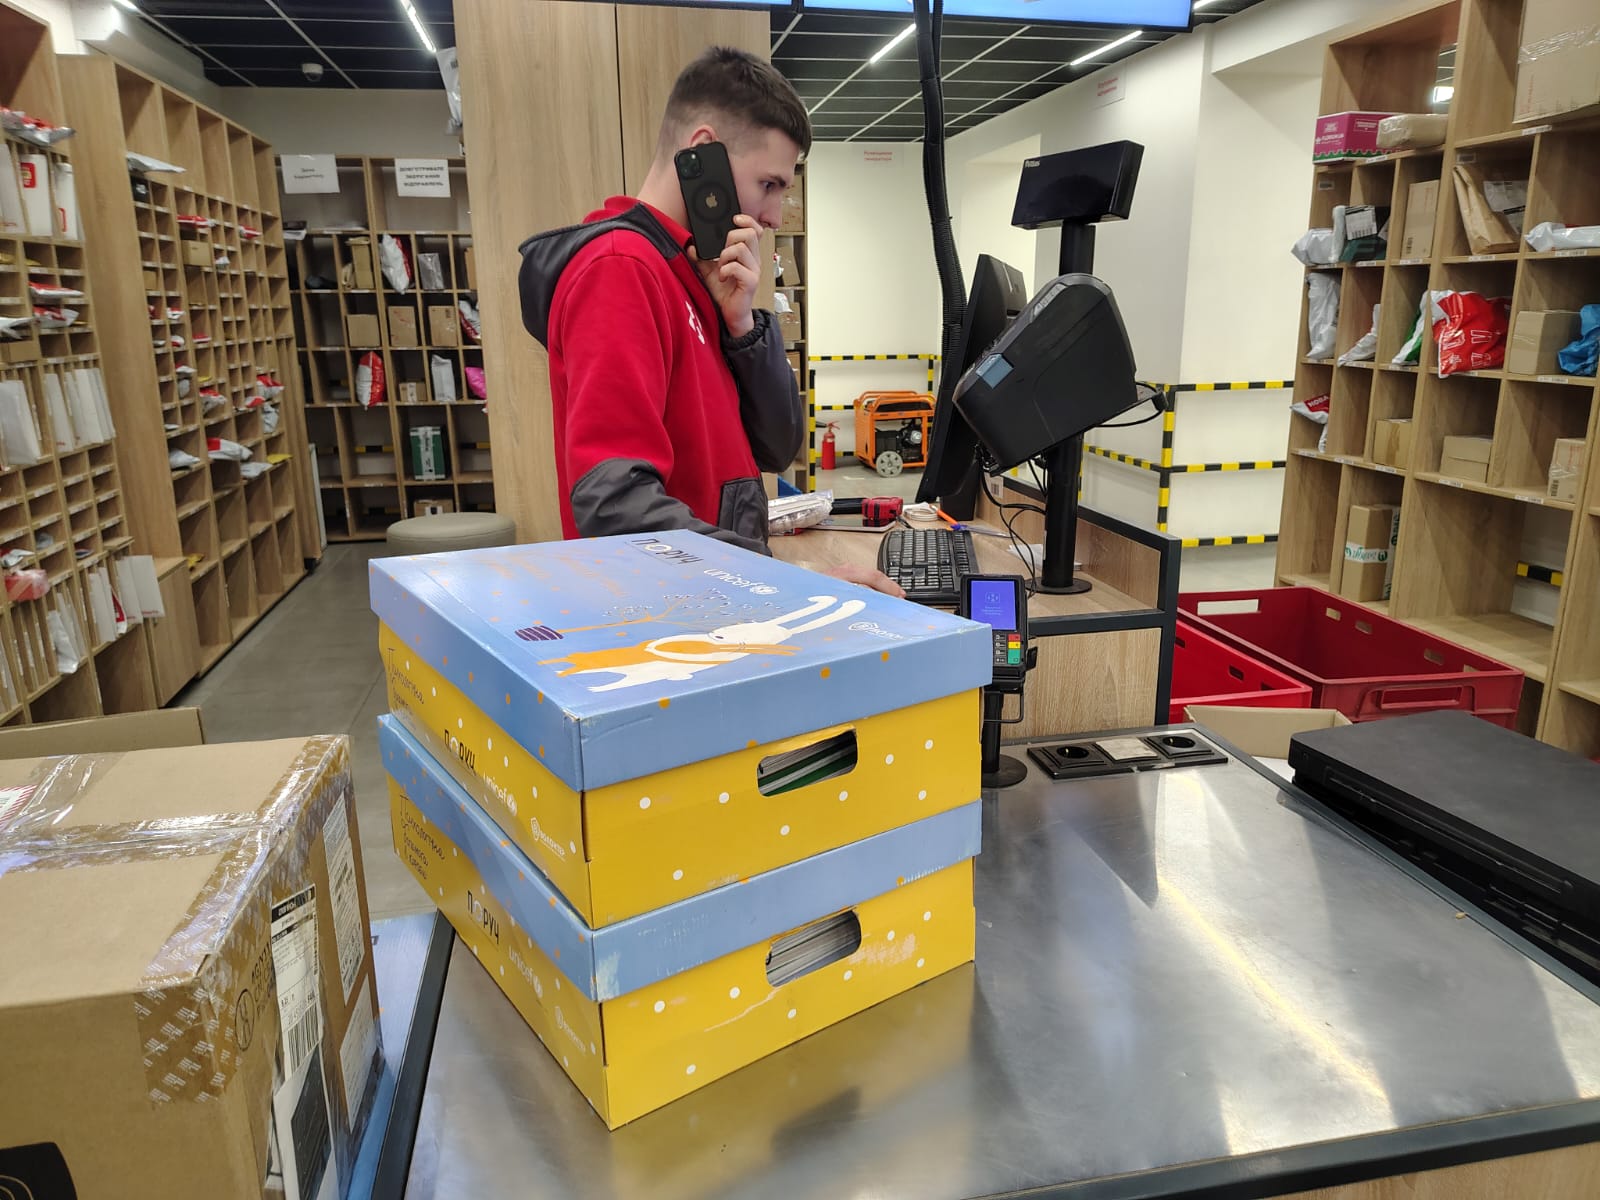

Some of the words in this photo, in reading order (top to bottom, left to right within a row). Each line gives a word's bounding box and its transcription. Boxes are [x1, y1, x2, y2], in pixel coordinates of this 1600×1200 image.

[632, 538, 704, 565] ПОРУЧ
[704, 568, 765, 588] unicef
[444, 729, 477, 777] ПОРУЧ
[483, 771, 509, 805] unicef
[467, 890, 500, 945] ПОРУЧ
[508, 945, 535, 983] unicef
